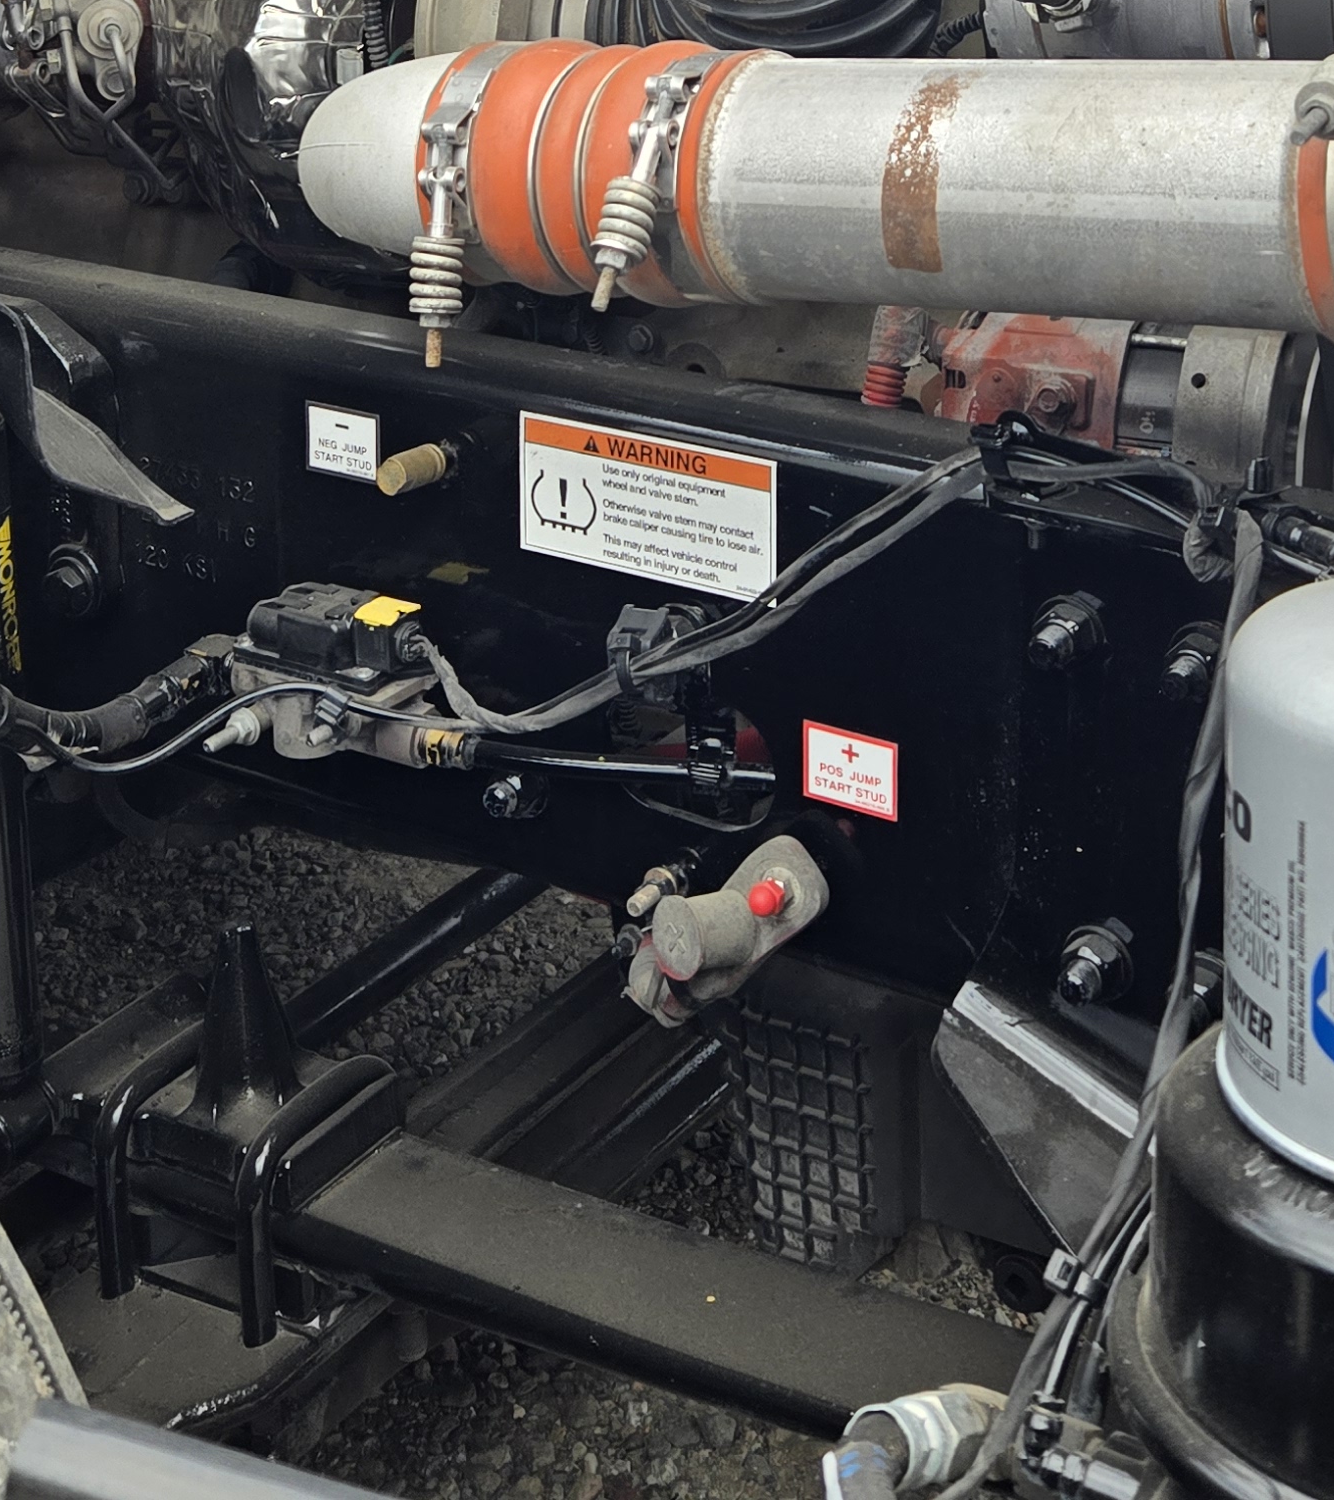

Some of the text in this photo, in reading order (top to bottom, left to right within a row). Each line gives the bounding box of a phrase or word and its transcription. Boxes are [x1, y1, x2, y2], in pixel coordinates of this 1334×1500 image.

[314, 449, 372, 471] START STUD
[318, 437, 367, 456] NEG JUMP
[606, 436, 707, 475] WARNING
[602, 463, 726, 498] Use only original equipment
[602, 478, 699, 507] wheel and valve stem.
[602, 498, 755, 541] Otherwise valve stem may contact
[603, 511, 764, 556] brake caliper causing tire to lose air.
[603, 533, 738, 572] This may affect vehicle control
[603, 549, 721, 583] resulting in injury or death.
[814, 776, 888, 804] START STUD
[819, 762, 882, 787] POS JUMP
